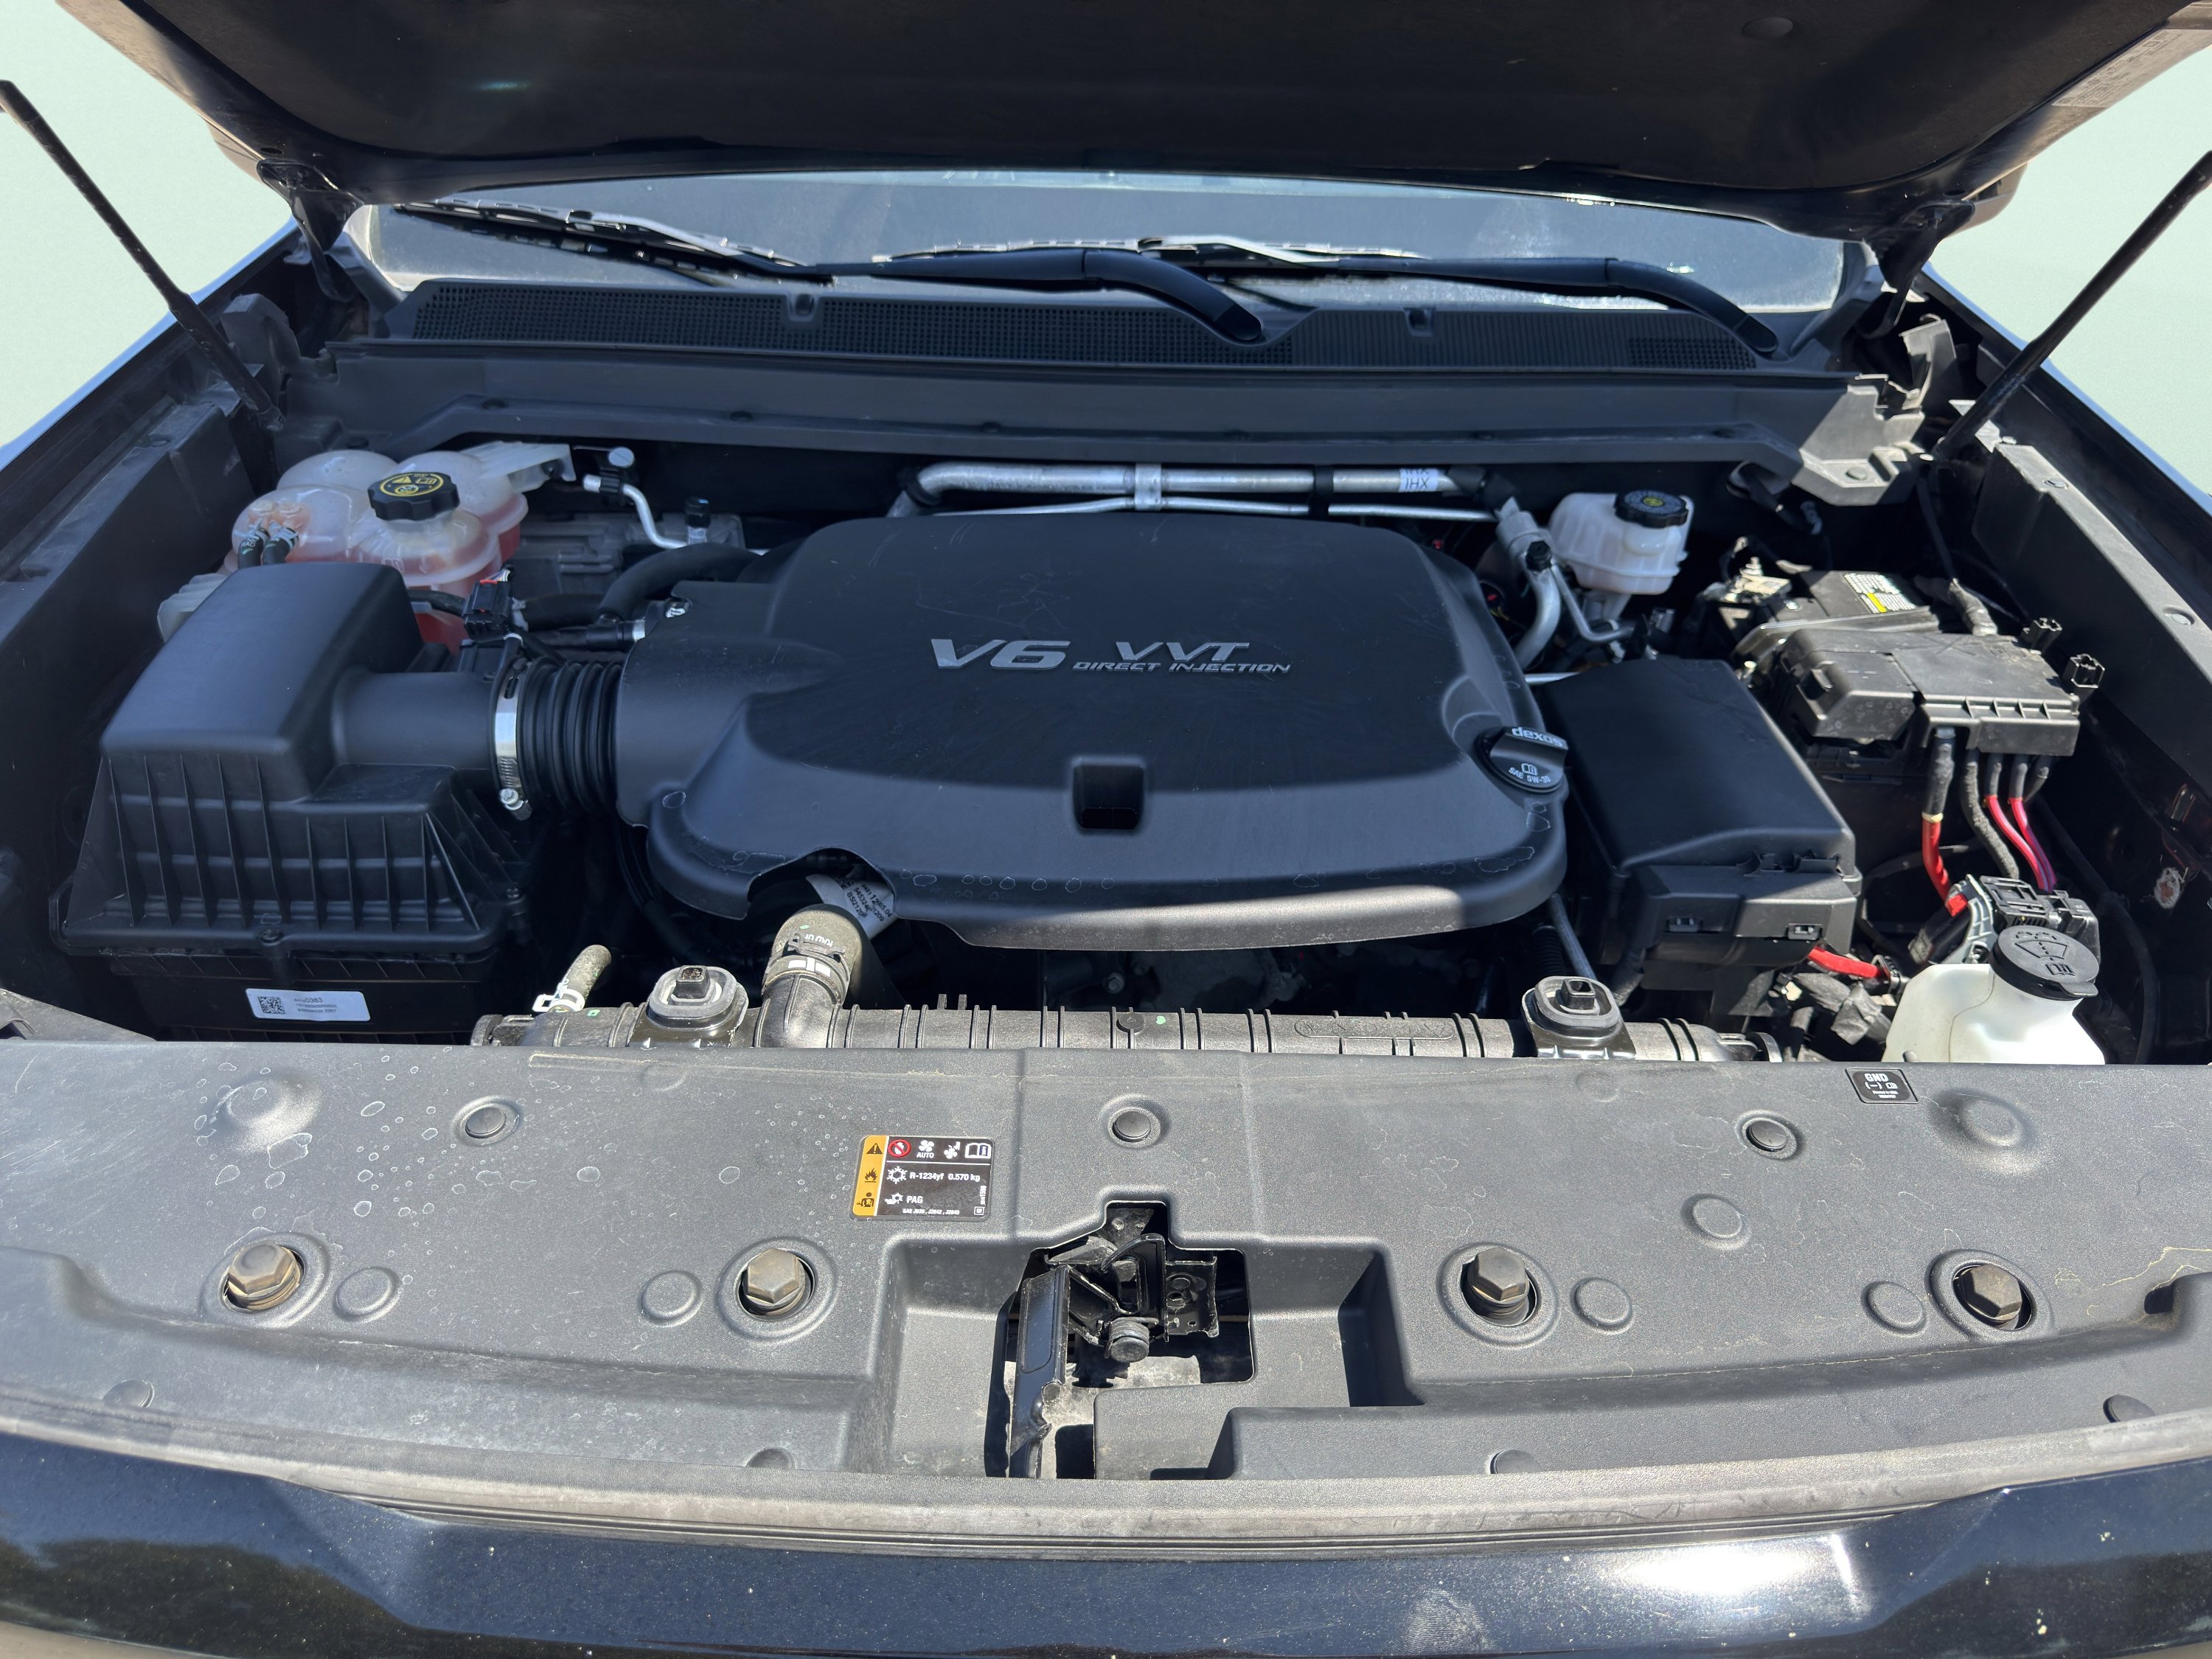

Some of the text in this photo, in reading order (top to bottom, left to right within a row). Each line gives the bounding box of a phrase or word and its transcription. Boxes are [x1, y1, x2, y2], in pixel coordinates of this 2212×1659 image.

[931, 639, 1250, 670] V6 VVT
[1073, 661, 1290, 672] DIRECT INJECTION
[1512, 726, 1563, 747] dexos
[1508, 767, 1551, 784] SAE 5W-30
[1864, 1073, 1889, 1082] GND
[909, 1172, 944, 1181] R-1234yf
[970, 1173, 981, 1182] kg
[906, 1195, 923, 1203] PAG
